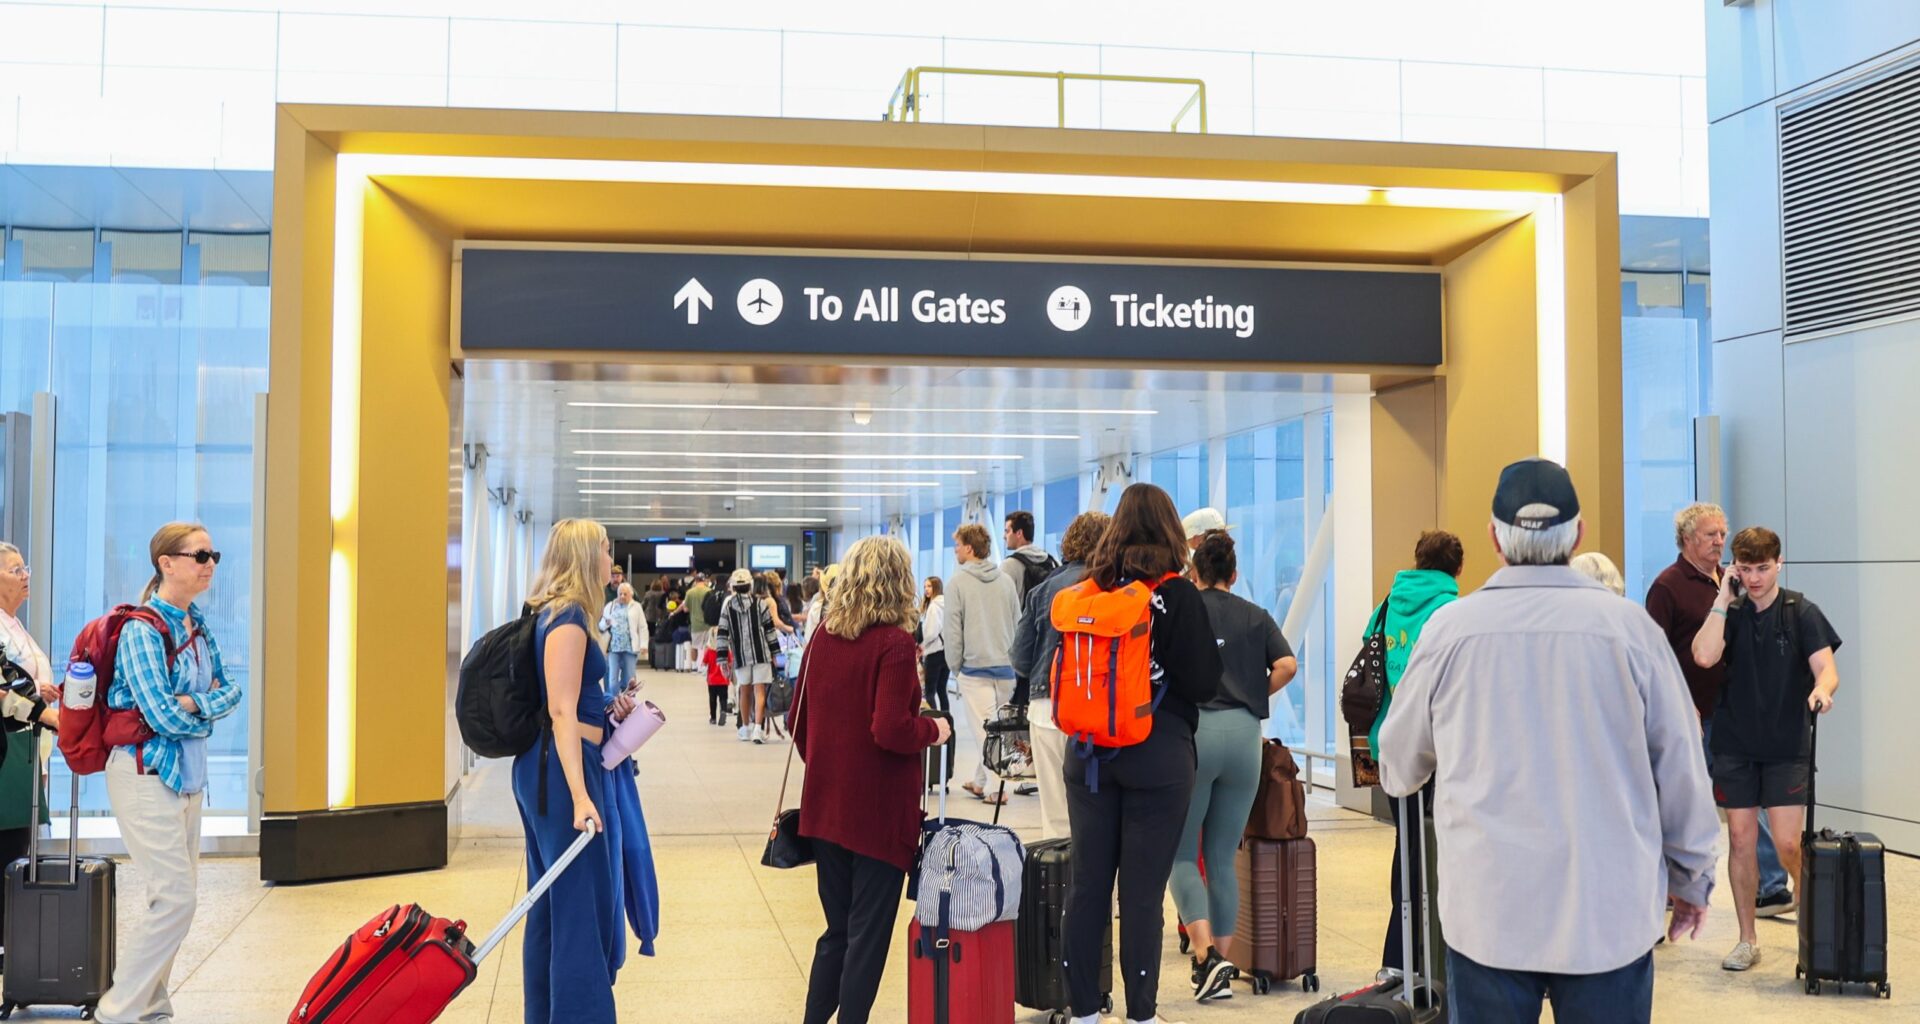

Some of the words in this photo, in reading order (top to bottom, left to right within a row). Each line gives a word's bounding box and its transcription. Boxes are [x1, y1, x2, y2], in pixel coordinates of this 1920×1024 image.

[804, 288, 842, 322] To
[854, 287, 899, 322] All
[912, 290, 1006, 325] Gates
[1110, 294, 1255, 338] Ticketing
[1521, 520, 1543, 529] USAF
